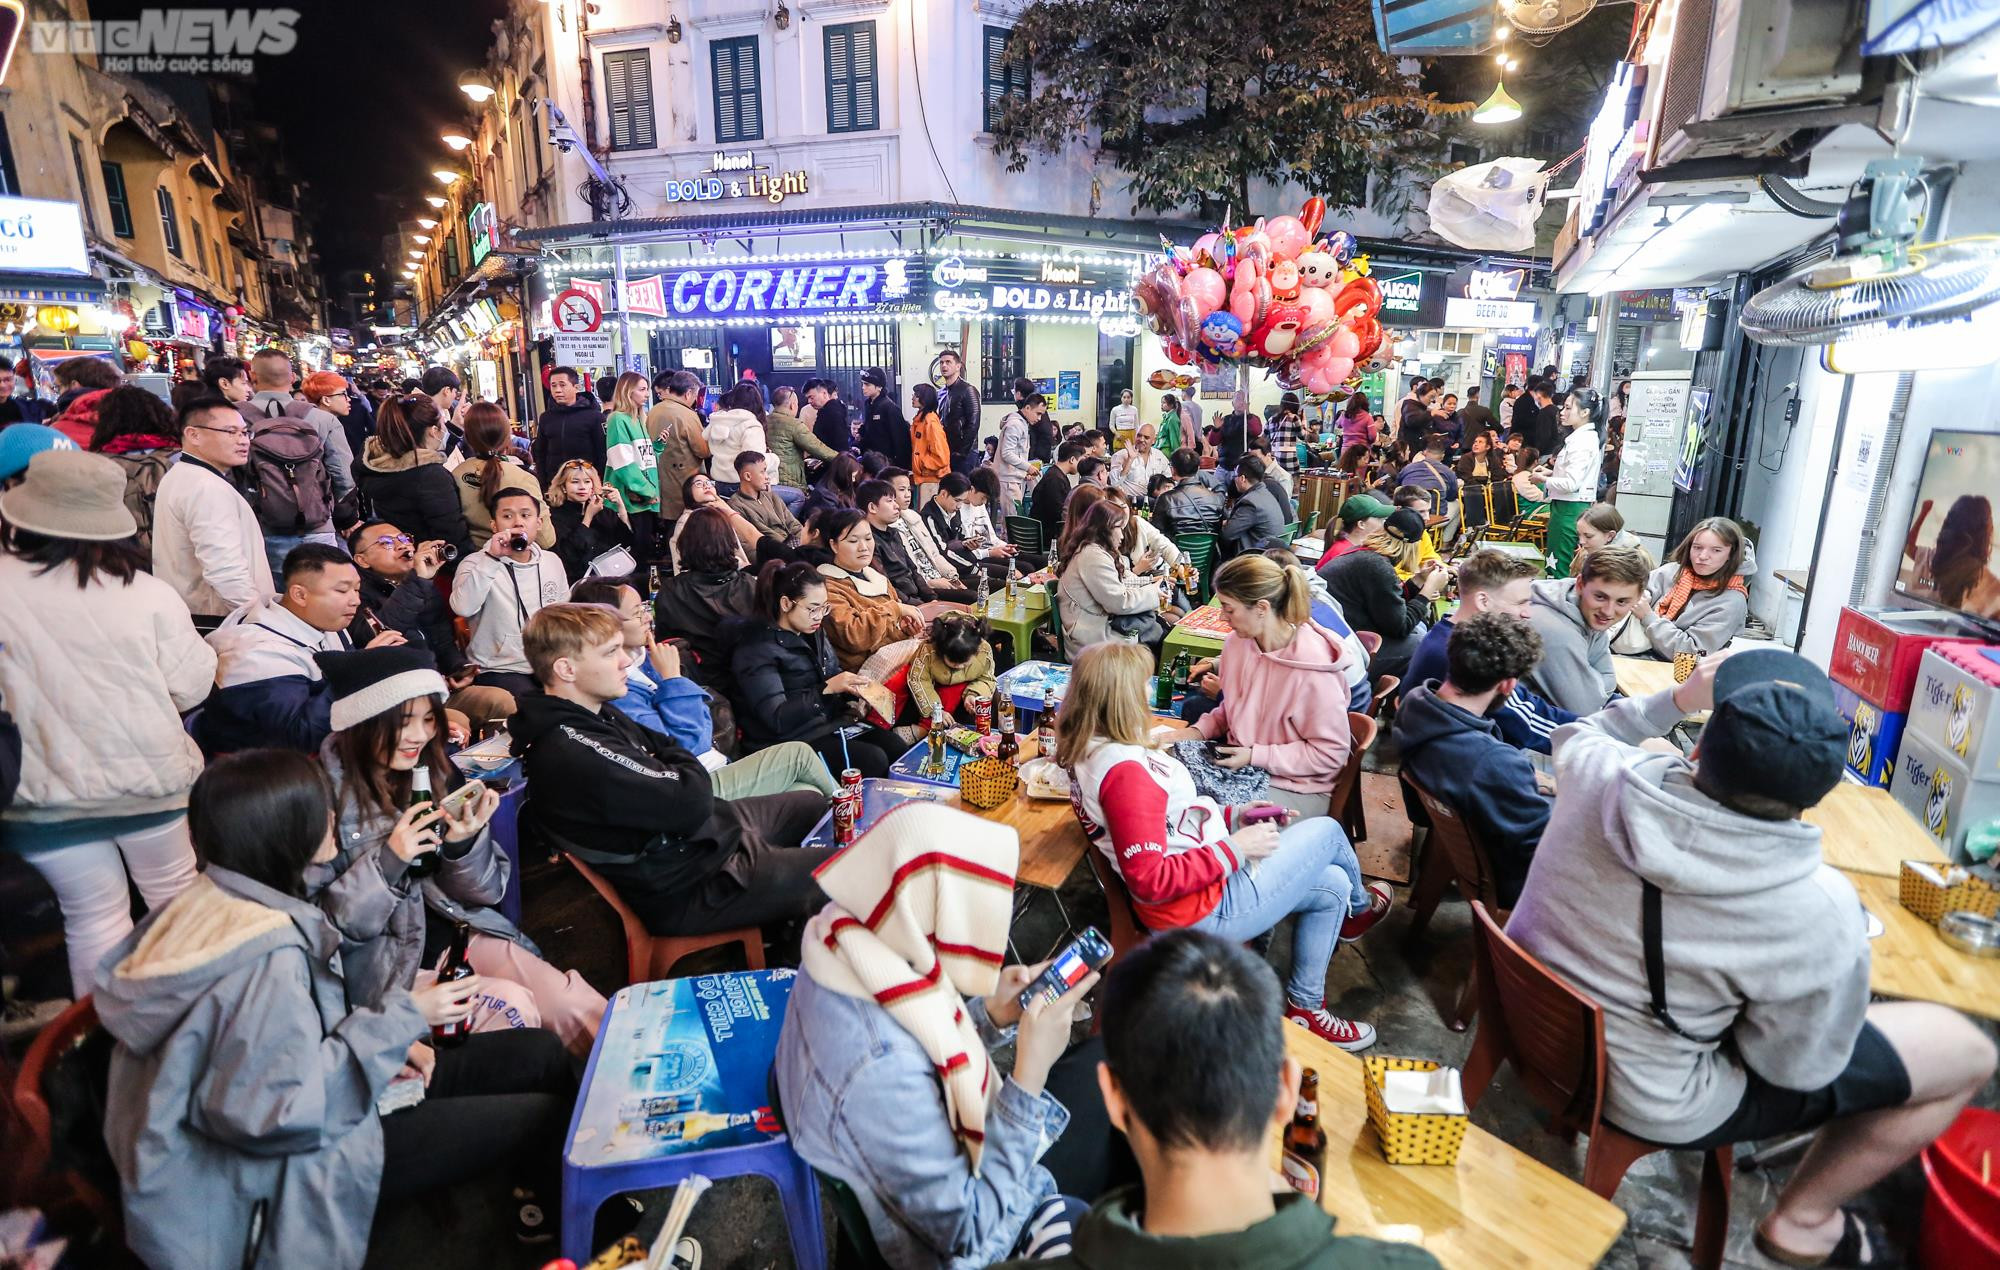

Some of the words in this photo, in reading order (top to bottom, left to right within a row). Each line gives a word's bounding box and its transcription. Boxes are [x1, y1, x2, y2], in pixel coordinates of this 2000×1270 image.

[666, 177, 725, 202] BOLD
[730, 181, 743, 198] &
[748, 170, 809, 203] Light
[672, 265, 877, 314] CORNER
[933, 290, 988, 313] Carlsberg
[992, 285, 1051, 310] BOLD
[1053, 292, 1066, 309] &
[1067, 288, 1130, 318] Light
[1377, 279, 1421, 301] SAIGON
[1847, 632, 1866, 656] HANOI
[1863, 644, 1880, 667] BEER
[1925, 675, 1952, 705] Tiger
[1906, 754, 1931, 787] Tiger
[705, 996, 734, 1044] CHILL
